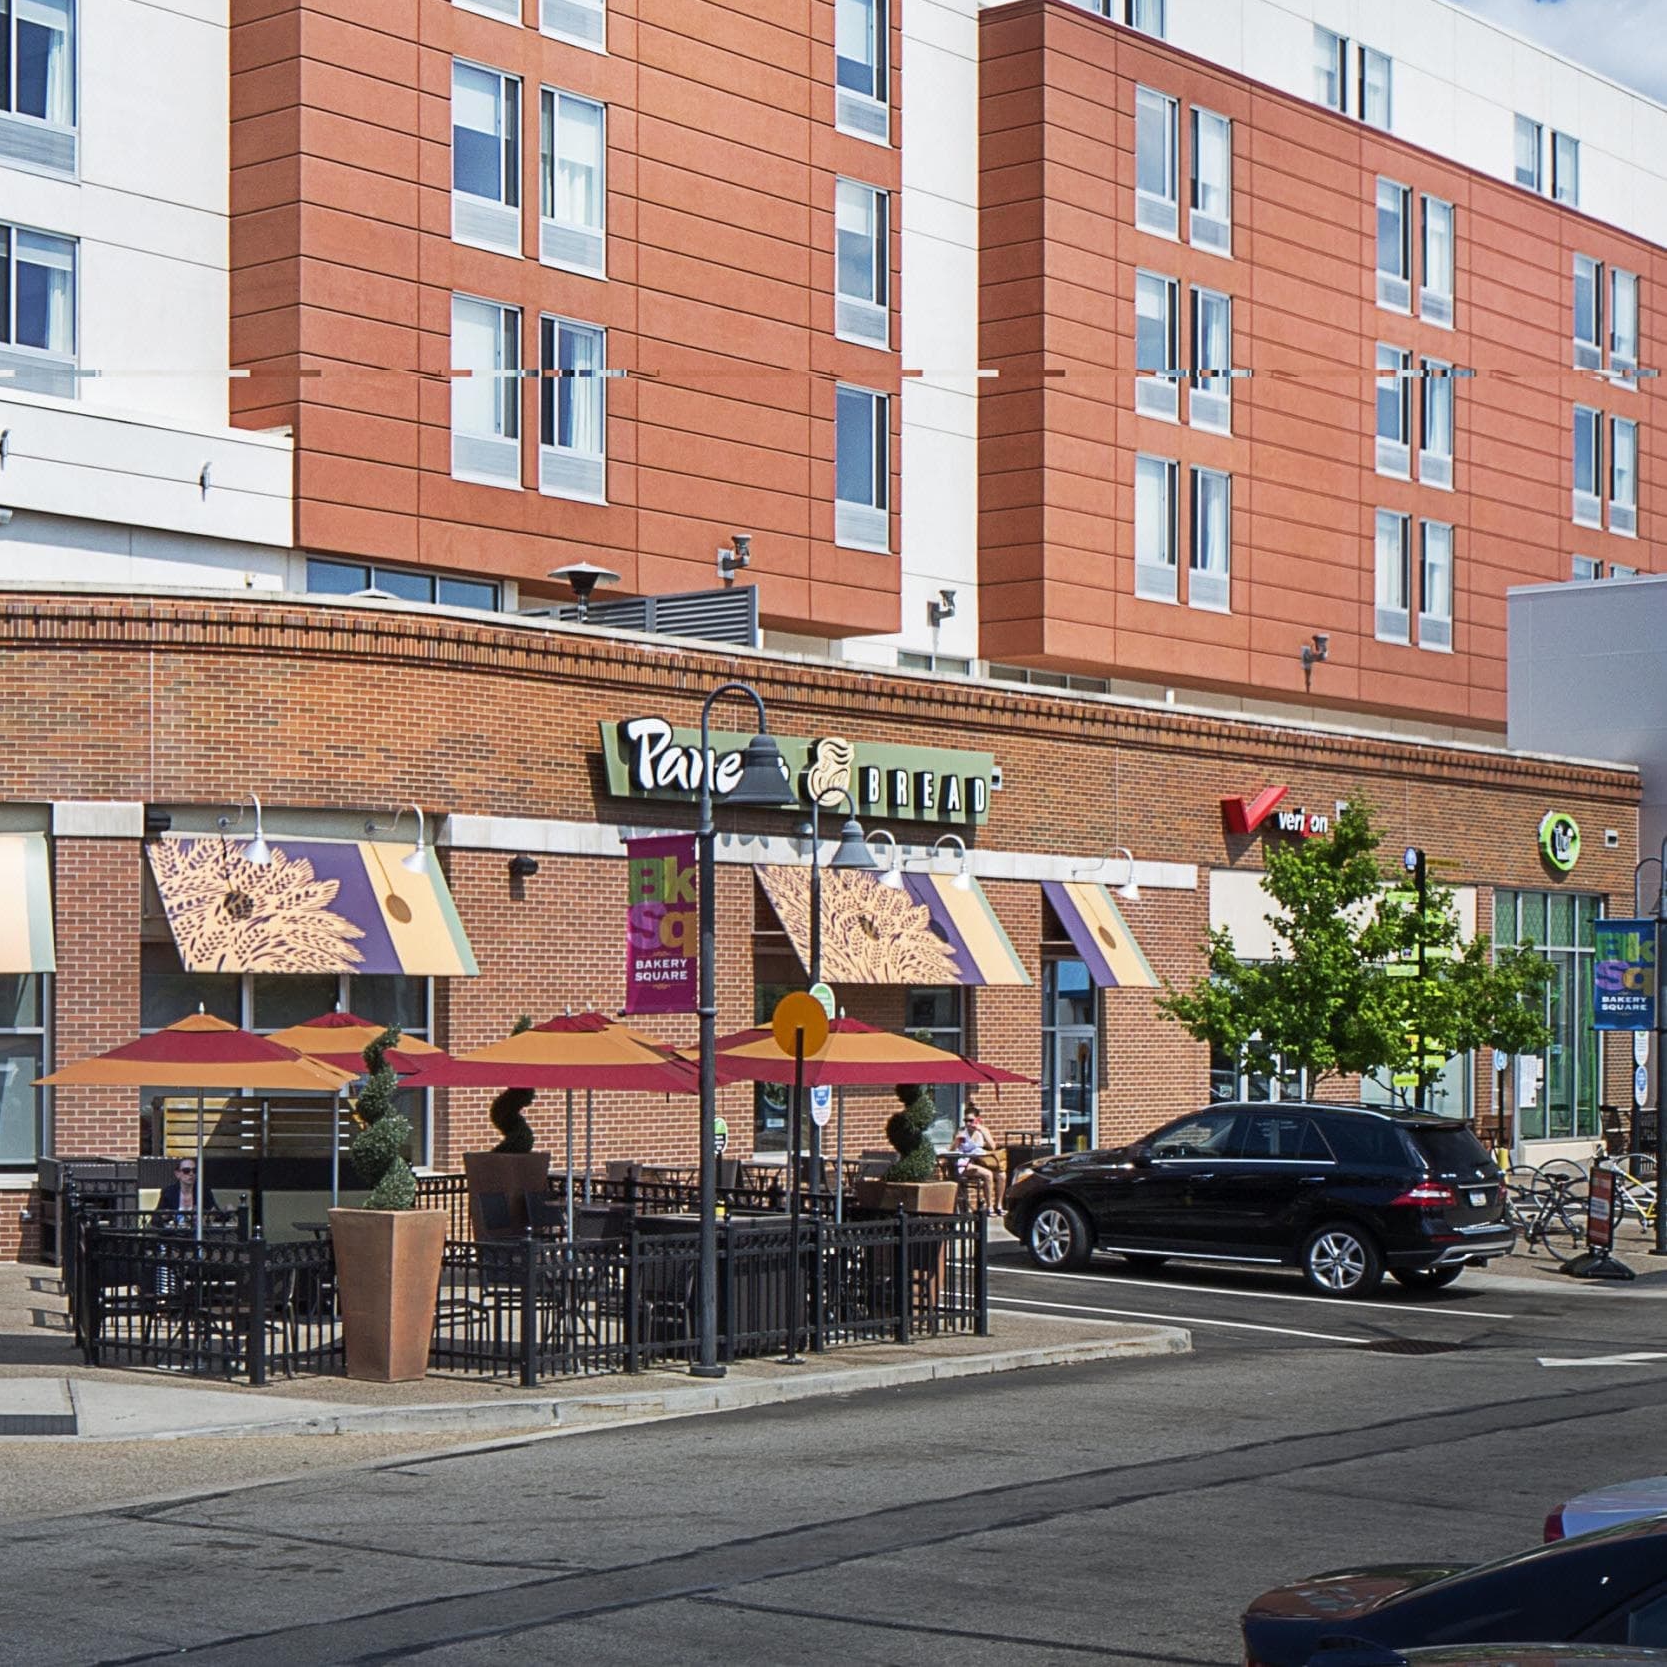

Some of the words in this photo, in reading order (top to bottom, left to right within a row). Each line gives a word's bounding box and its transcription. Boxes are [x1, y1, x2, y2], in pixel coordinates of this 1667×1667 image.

[627, 718, 790, 794] Pane
[868, 766, 986, 813] BREAD
[629, 856, 697, 905] Bk
[630, 901, 697, 957] Sq
[1596, 931, 1655, 963] Bk
[634, 970, 688, 982] SQUARE
[635, 958, 688, 970] BAKERY
[1595, 959, 1655, 997] Sq
[1601, 1003, 1648, 1011] SQUARE
